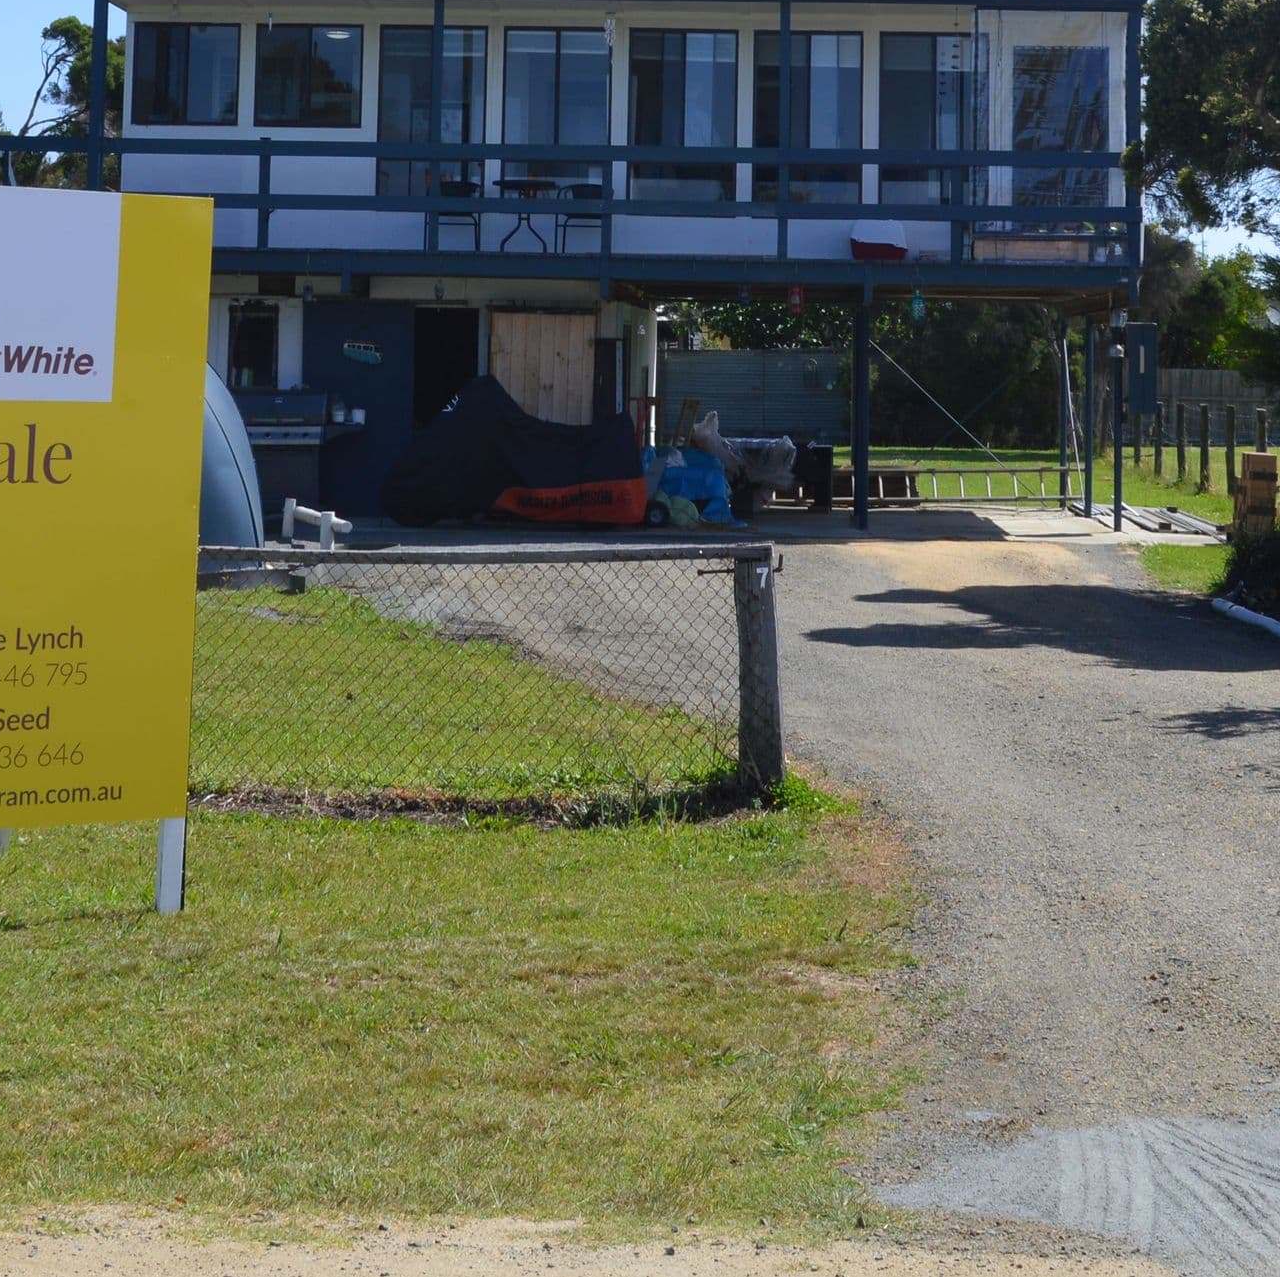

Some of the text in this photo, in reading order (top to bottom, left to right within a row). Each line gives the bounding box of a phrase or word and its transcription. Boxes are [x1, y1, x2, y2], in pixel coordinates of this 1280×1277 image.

[756, 567, 769, 589] 7
[15, 624, 84, 656] Lynch
[45, 661, 88, 687] 795
[37, 741, 85, 768] 646
